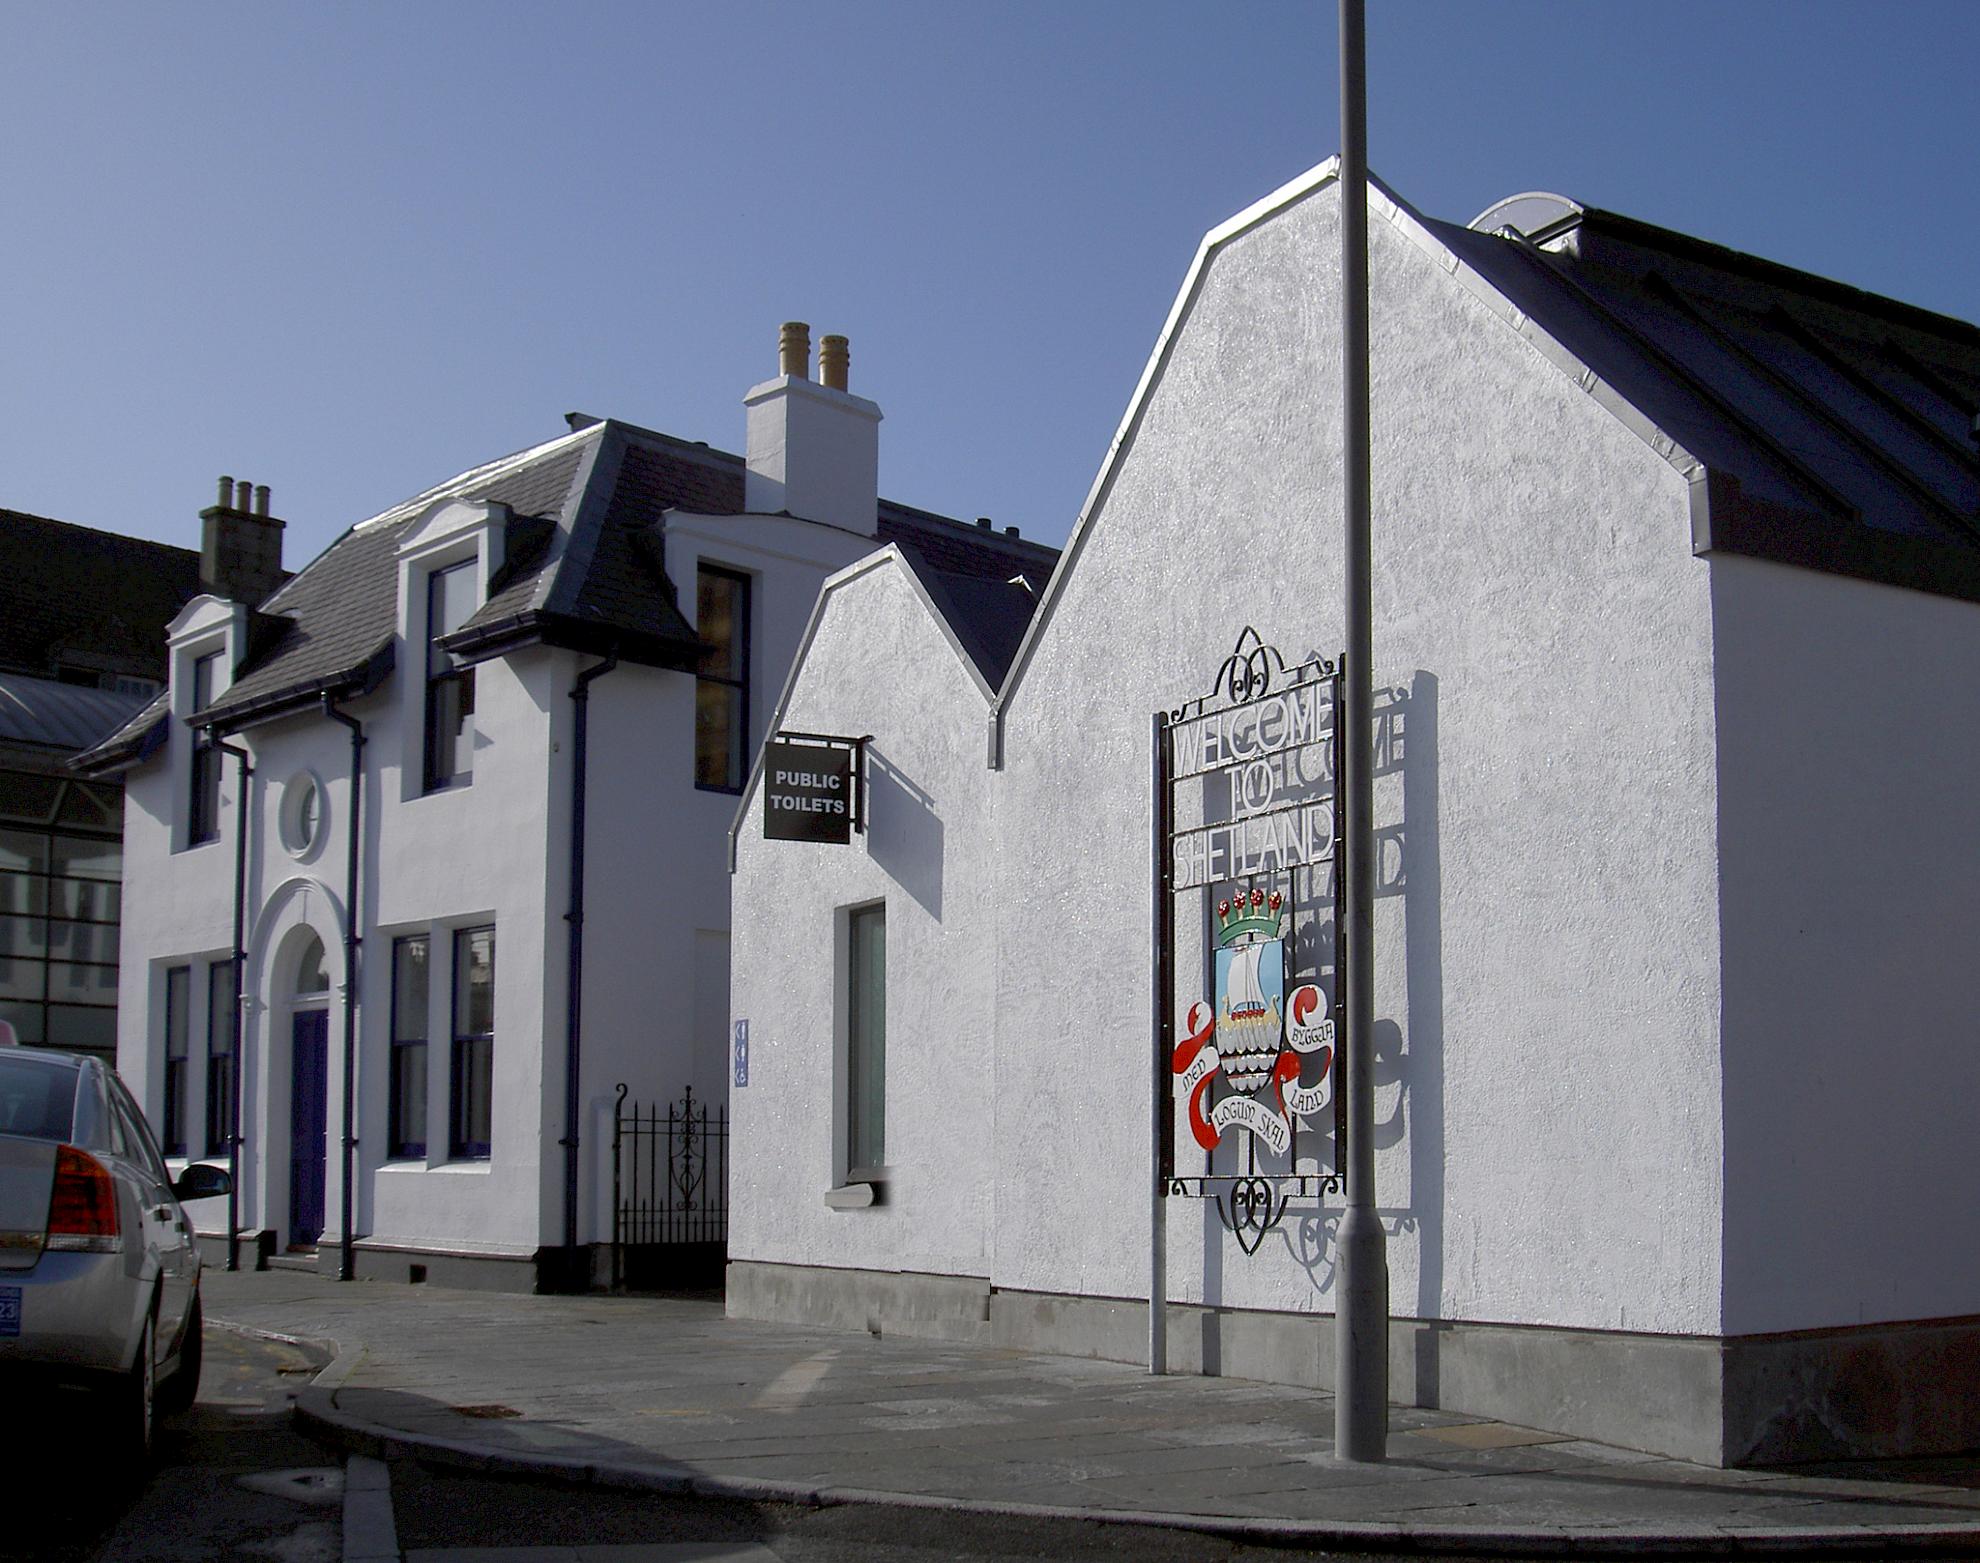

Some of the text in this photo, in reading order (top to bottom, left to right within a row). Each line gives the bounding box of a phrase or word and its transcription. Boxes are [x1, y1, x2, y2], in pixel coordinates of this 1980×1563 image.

[1173, 681, 1334, 777] WELCOME
[776, 770, 840, 789] PUBLIC
[1225, 760, 1274, 820] TO
[770, 795, 845, 813] TOILETS
[1173, 804, 1334, 889] SHETLAND
[1182, 1058, 1206, 1092] MED
[1291, 1089, 1324, 1112] LAND
[1214, 1101, 1284, 1150] LOGUM SKAL
